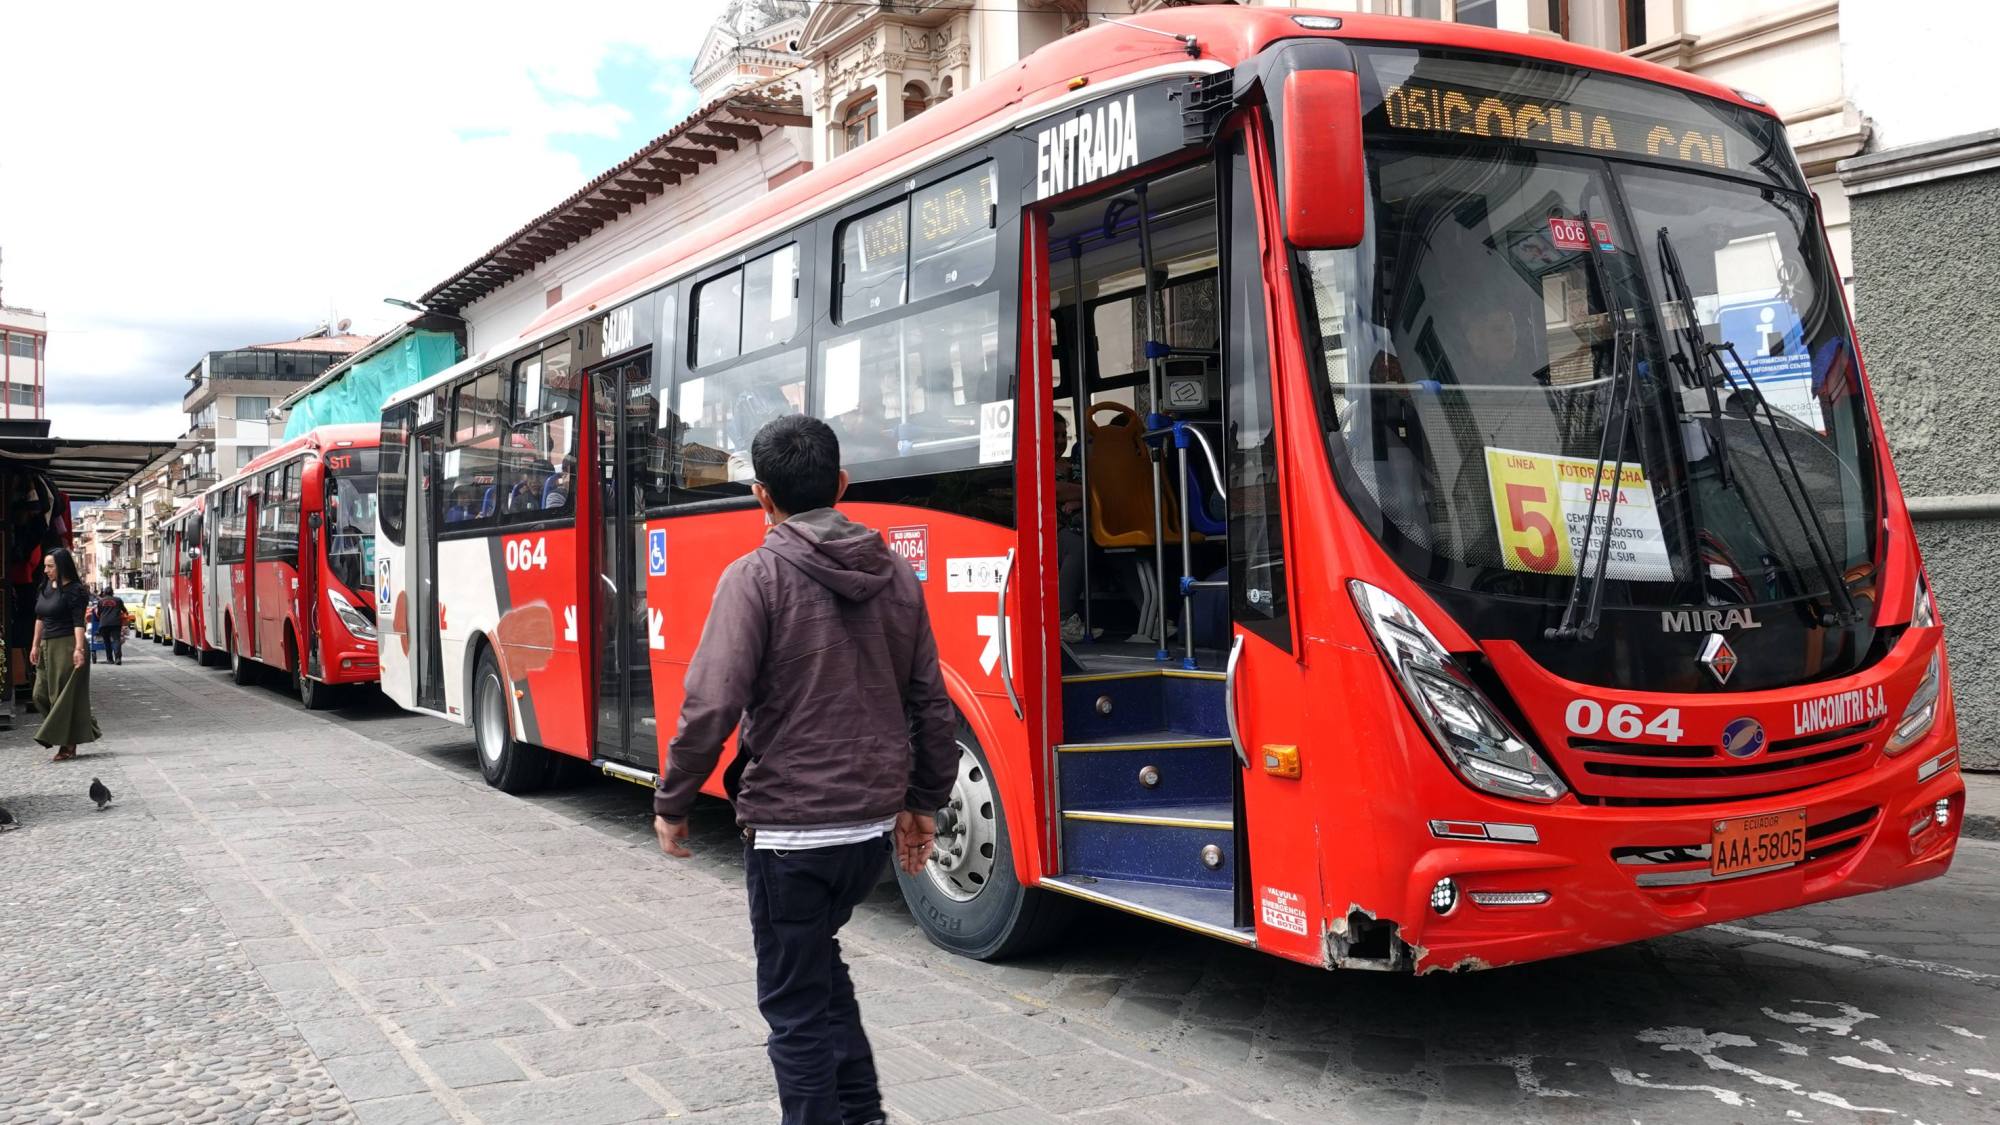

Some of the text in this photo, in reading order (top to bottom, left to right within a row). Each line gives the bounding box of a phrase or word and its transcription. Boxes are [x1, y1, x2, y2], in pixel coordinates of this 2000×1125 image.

[1036, 94, 1138, 200] ENTRADA
[602, 306, 633, 358] SALIDA
[983, 404, 1010, 430] NO
[1506, 456, 1536, 471] LÍNEA
[1558, 463, 1642, 483] TOTORCOCHA
[1505, 483, 1559, 573] 5
[506, 537, 547, 571] 064
[1616, 551, 1636, 562] SUR
[1661, 608, 1762, 632] MIRAL
[1565, 698, 1684, 743] 064
[1793, 685, 1888, 735] LANCOMTRI S.A.
[1744, 816, 1779, 831] ECUADOR
[1717, 828, 1803, 870] AAA-5805
[1266, 909, 1304, 927] HALE
